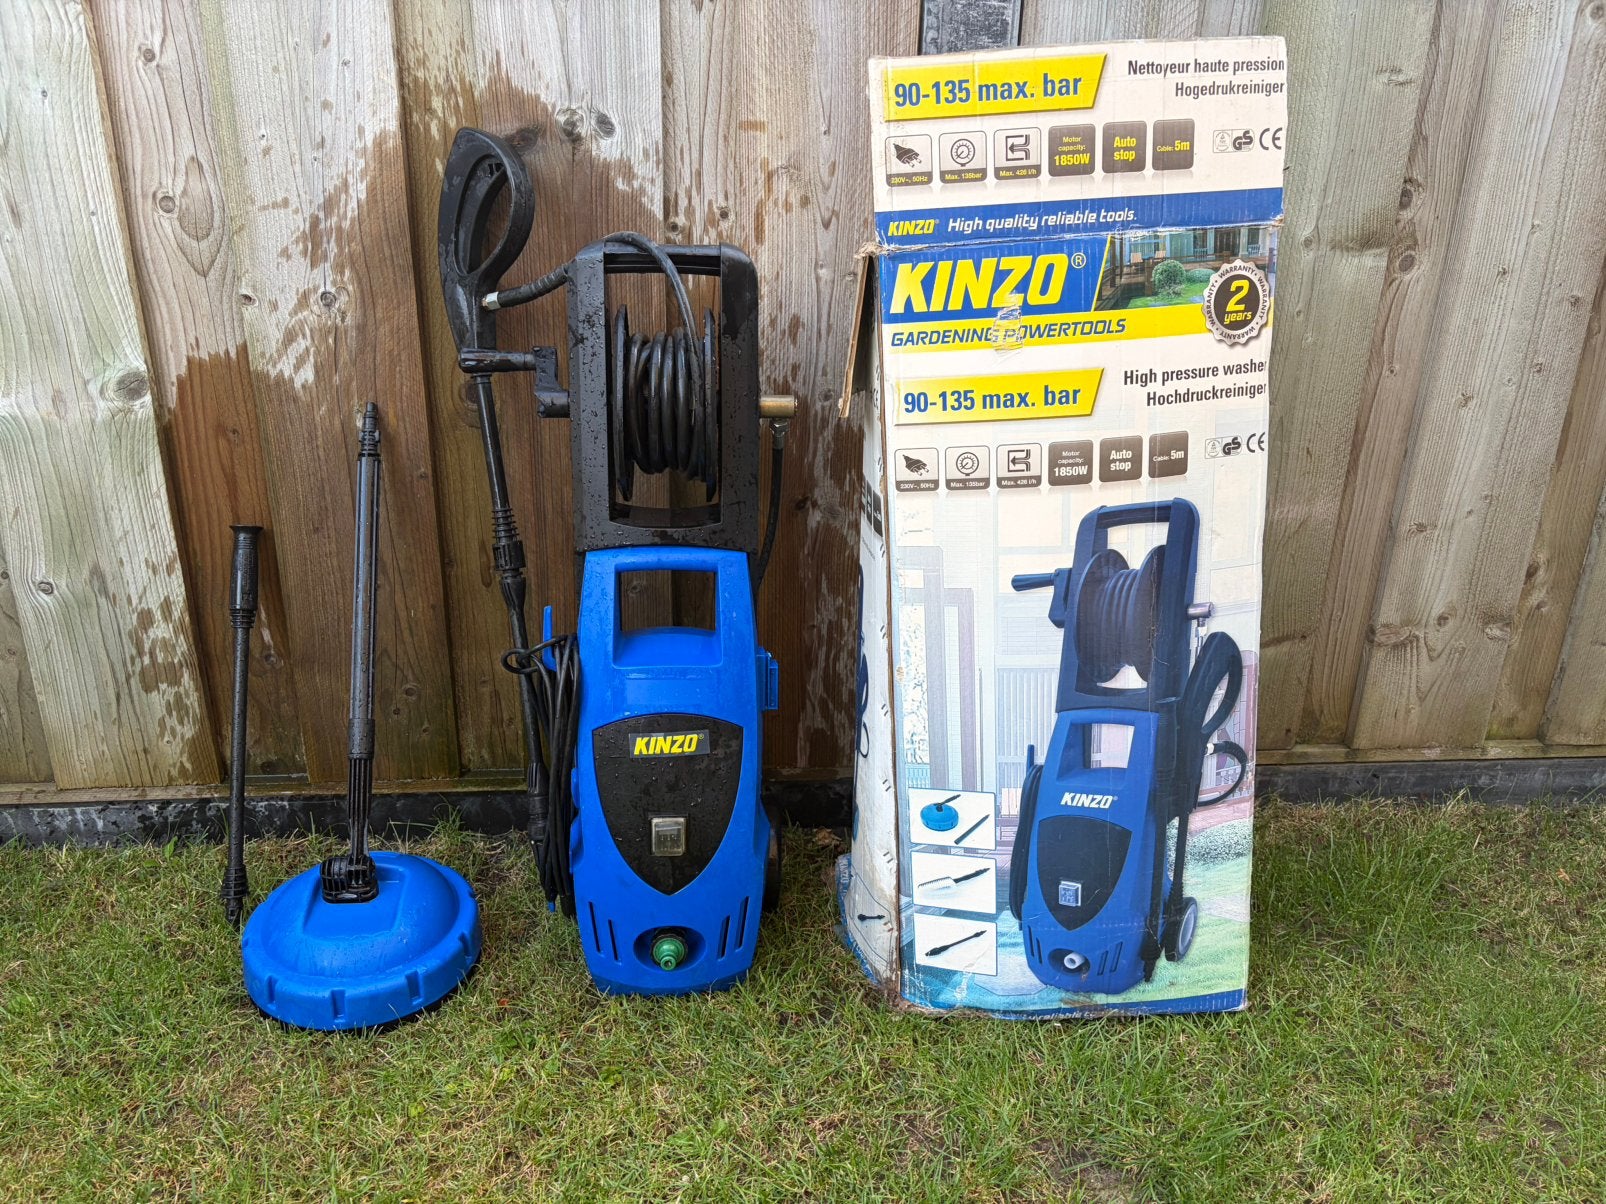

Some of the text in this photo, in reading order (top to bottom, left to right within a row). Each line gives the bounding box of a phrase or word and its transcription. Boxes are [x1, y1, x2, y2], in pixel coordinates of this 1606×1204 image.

[1128, 56, 1285, 80] Nettoyeur haute pression
[894, 72, 1082, 108] 90-135 max. bar
[1175, 79, 1285, 100] Hogedrukreiniger
[1058, 144, 1086, 152] capacity:
[1113, 136, 1136, 148] Auto
[1174, 140, 1190, 151] 5m
[1054, 153, 1090, 166] 1850W
[1113, 149, 1136, 162] stop
[961, 172, 983, 180] 135bar
[1000, 169, 1014, 177] Max.
[948, 207, 1137, 234] High quality reliable tools.
[1218, 265, 1256, 279] WARRANTY
[1226, 279, 1250, 312] 2
[1257, 276, 1268, 321] WARRANTY
[1206, 284, 1216, 327] WARRANTY
[1224, 312, 1253, 324] years
[891, 318, 1127, 347] GARDENING POWERTOOLS
[1124, 368, 1157, 388] High
[1161, 365, 1219, 387] pressure
[904, 389, 976, 413] 90-135
[982, 391, 1036, 410] max.
[1043, 384, 1081, 406] bar
[1147, 381, 1267, 407] Hochdruckreiniger
[1109, 449, 1132, 460] Auto
[1170, 450, 1185, 460] 5m
[1053, 465, 1089, 477] 1850W
[1110, 461, 1132, 472] stop
